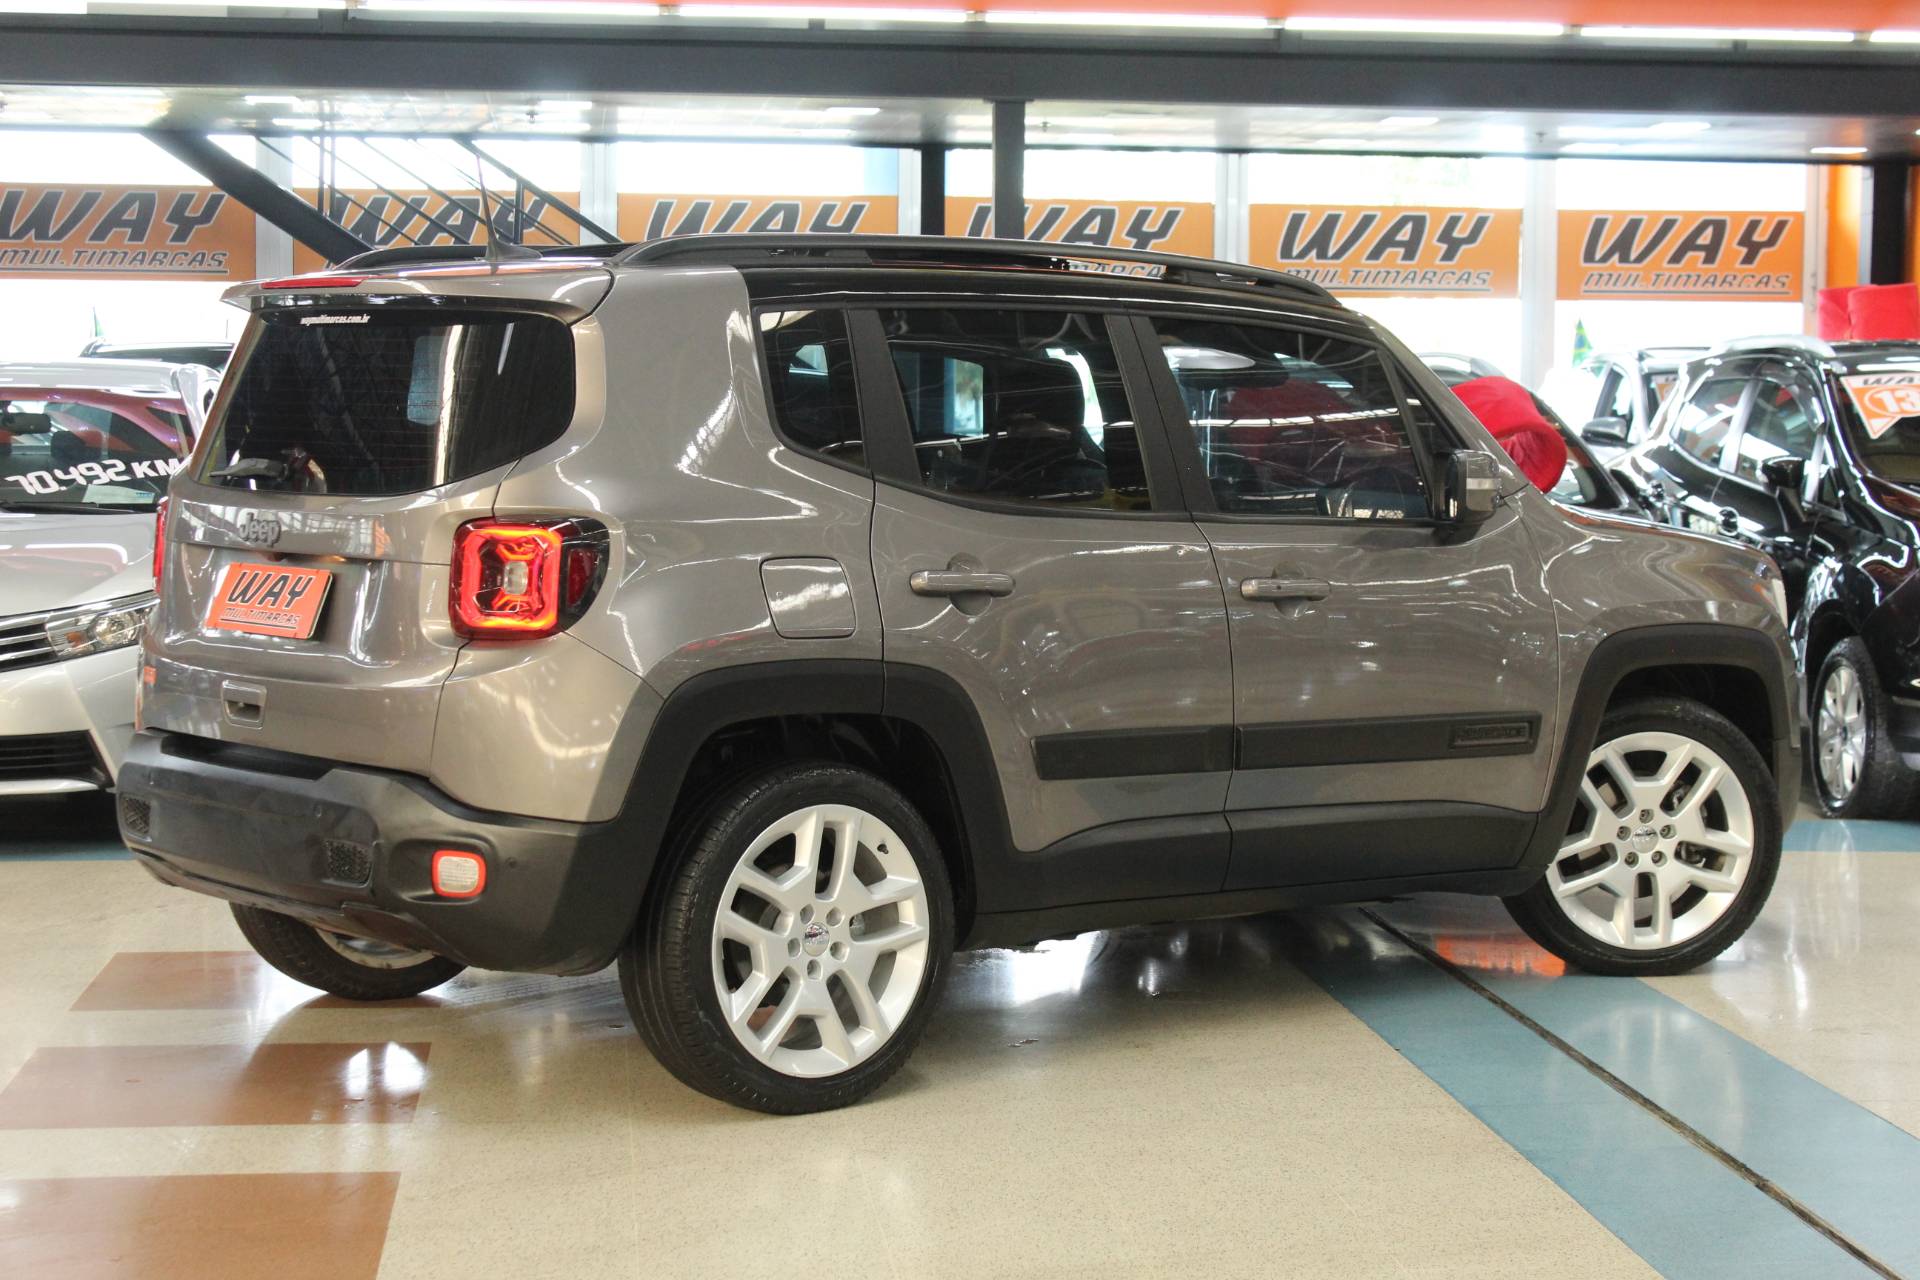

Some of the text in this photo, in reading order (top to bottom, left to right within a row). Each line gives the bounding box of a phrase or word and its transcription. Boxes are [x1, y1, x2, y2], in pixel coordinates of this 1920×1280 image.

[0, 189, 227, 245] WAY
[645, 200, 870, 241] WAY
[1277, 210, 1494, 264] WAY
[1581, 215, 1793, 267] WAY
[0, 248, 229, 268] MULTIMARCAS
[1583, 272, 1792, 290] MULTIMARCAS
[5, 458, 183, 495] 10.492 KM
[239, 511, 282, 547] Jeep
[225, 569, 316, 610] WAY
[223, 607, 302, 626] MULTIMARCAS
